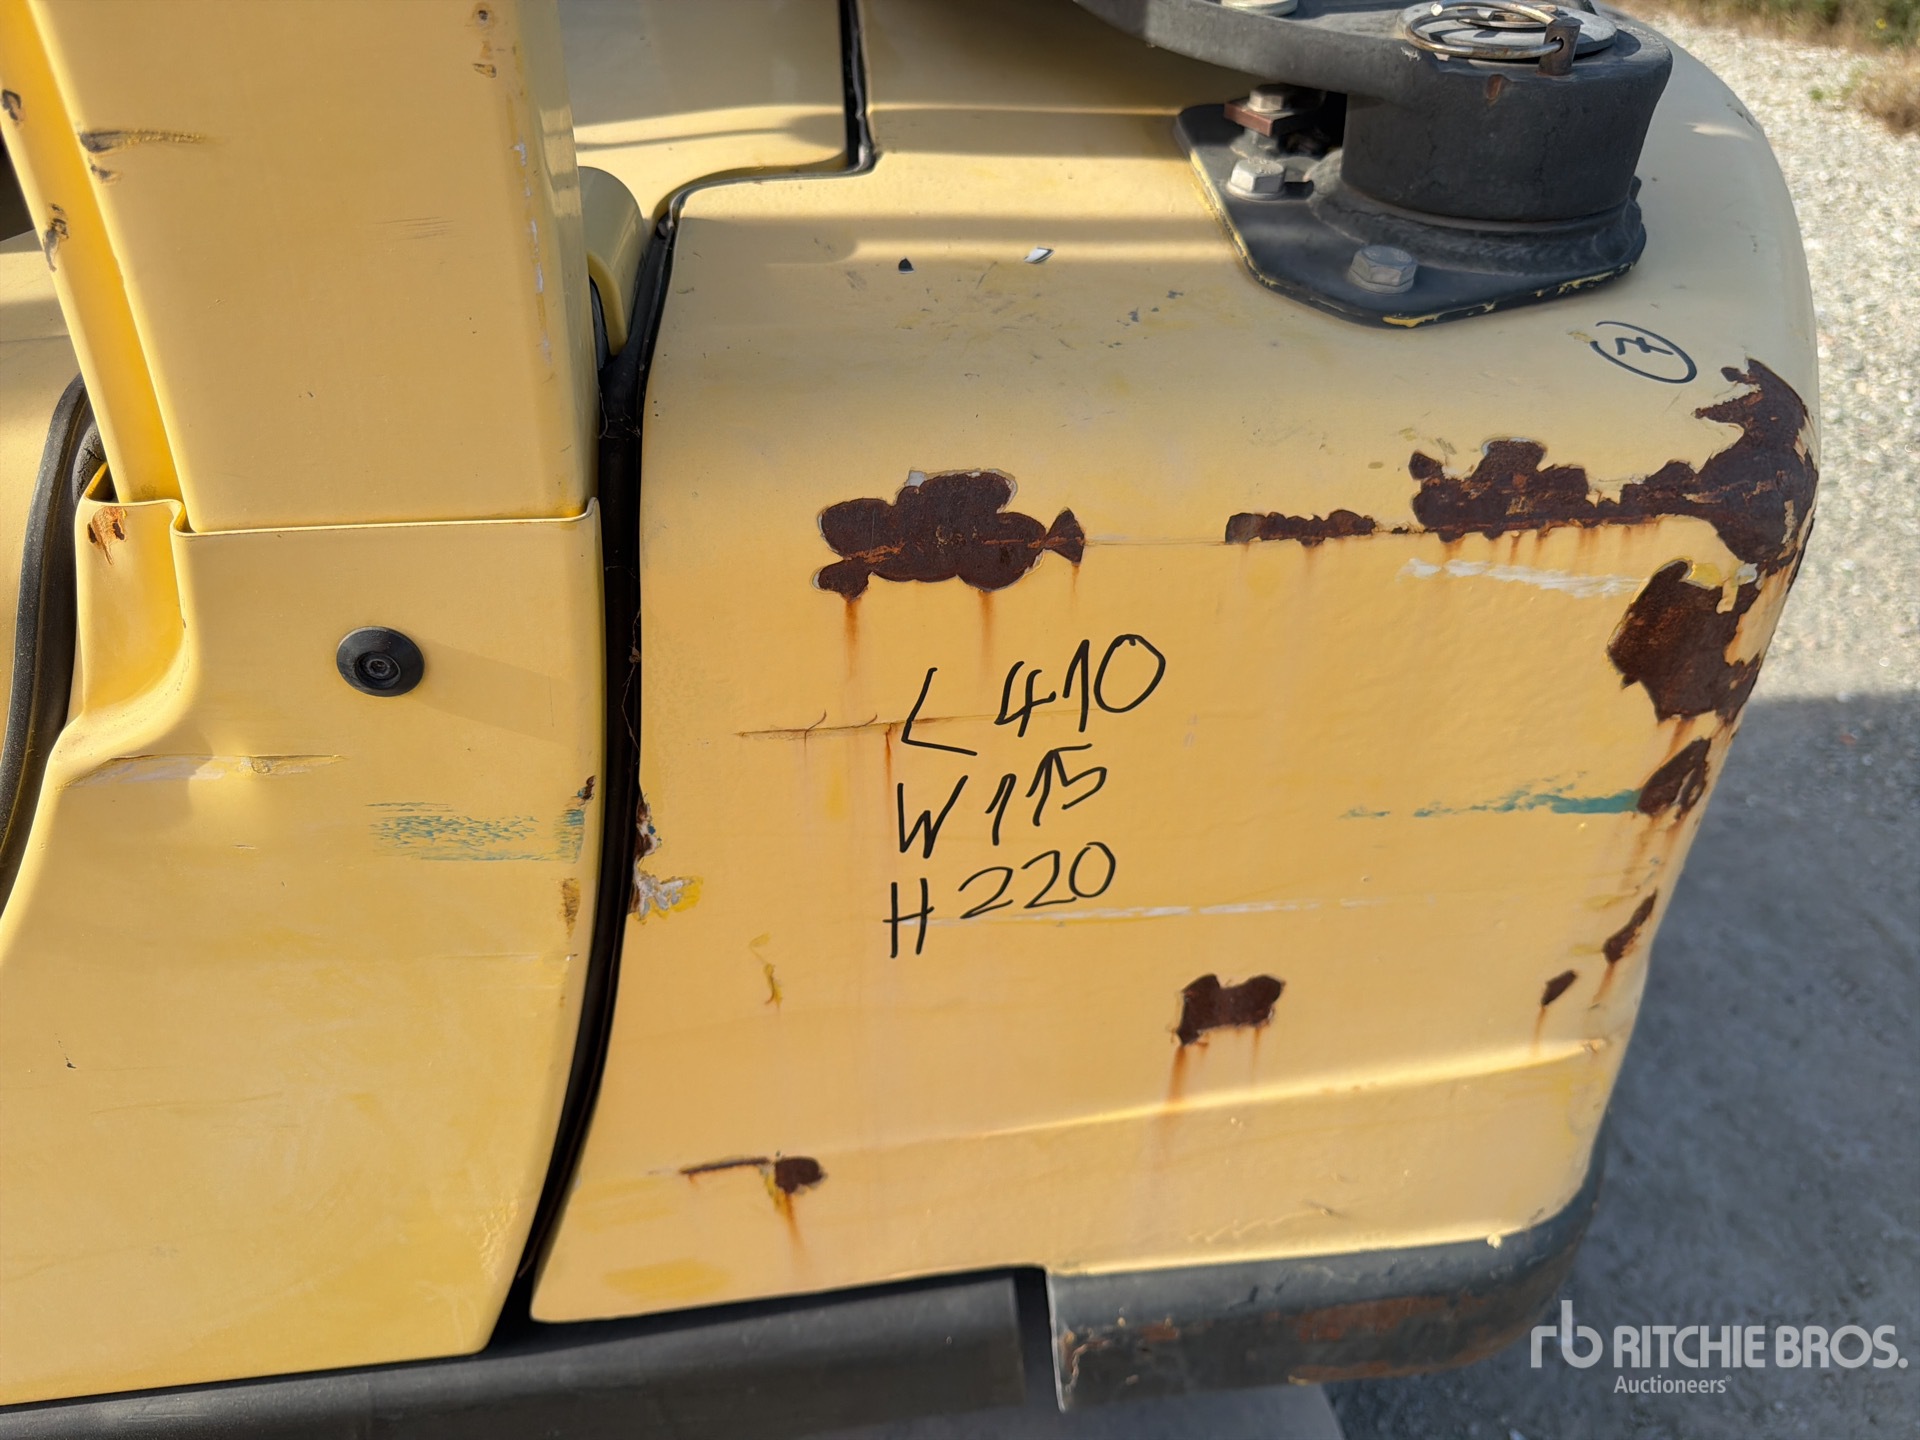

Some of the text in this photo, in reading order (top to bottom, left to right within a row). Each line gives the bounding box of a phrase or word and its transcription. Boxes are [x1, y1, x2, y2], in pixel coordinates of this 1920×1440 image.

[994, 634, 1166, 738] 410
[897, 743, 1107, 859] W 115
[882, 841, 1116, 959] H 220
